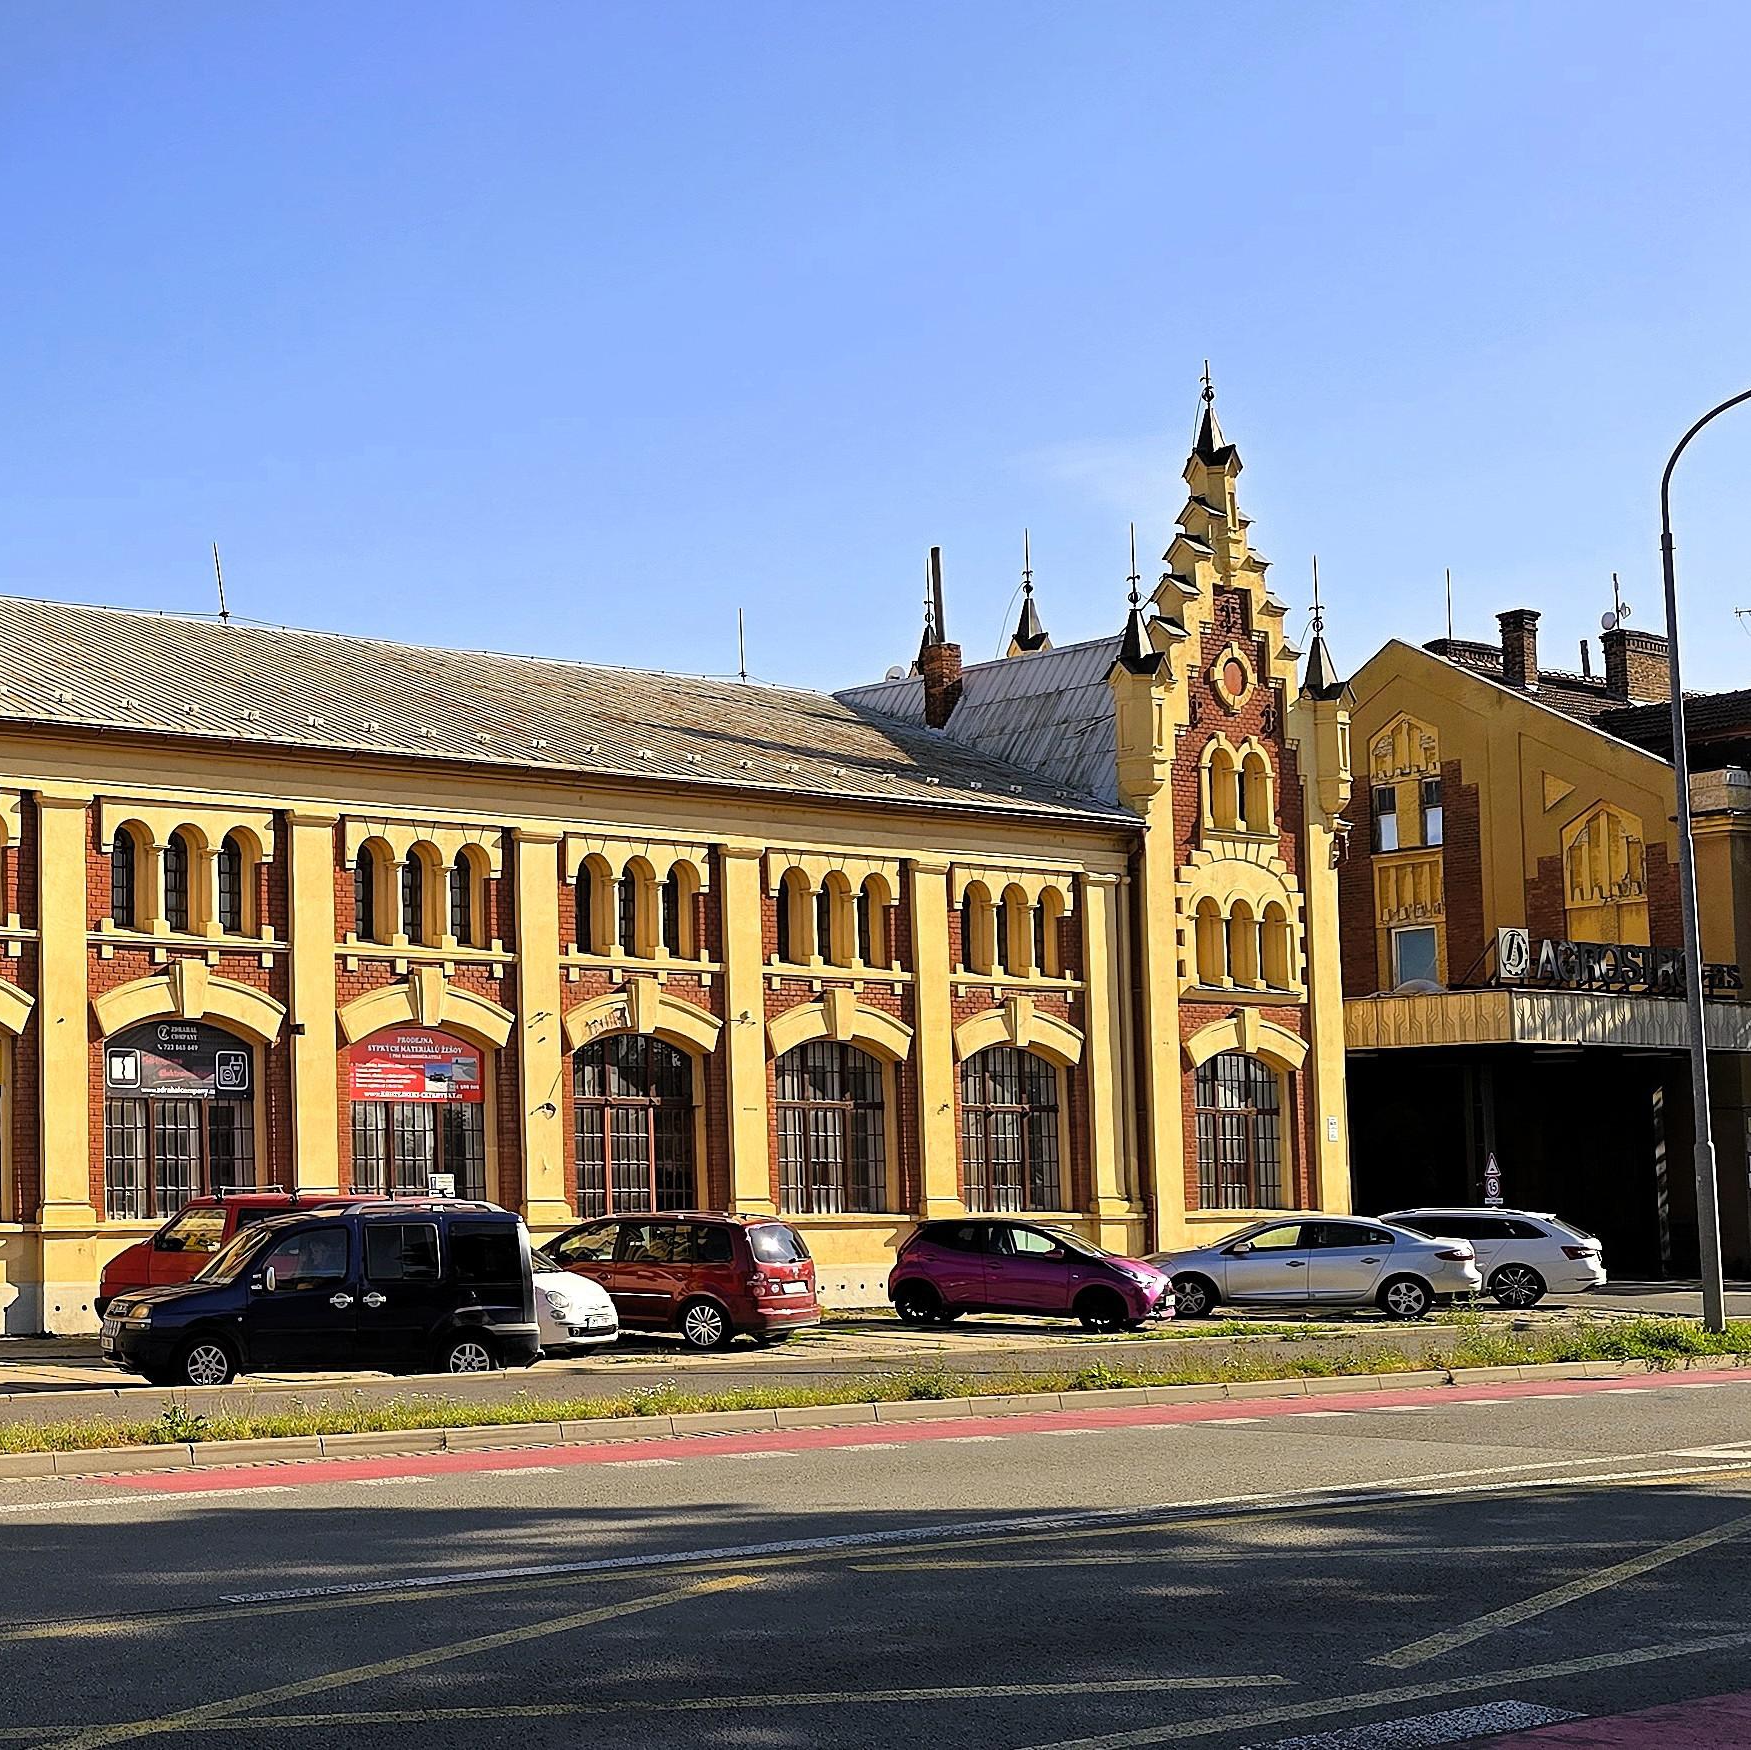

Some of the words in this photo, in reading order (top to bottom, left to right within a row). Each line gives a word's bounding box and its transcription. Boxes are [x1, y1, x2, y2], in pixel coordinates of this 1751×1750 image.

[1537, 939, 1687, 985] AGROSTRO
[396, 1036, 434, 1045] PRODEJNA
[1488, 1181, 1498, 1193] 15
